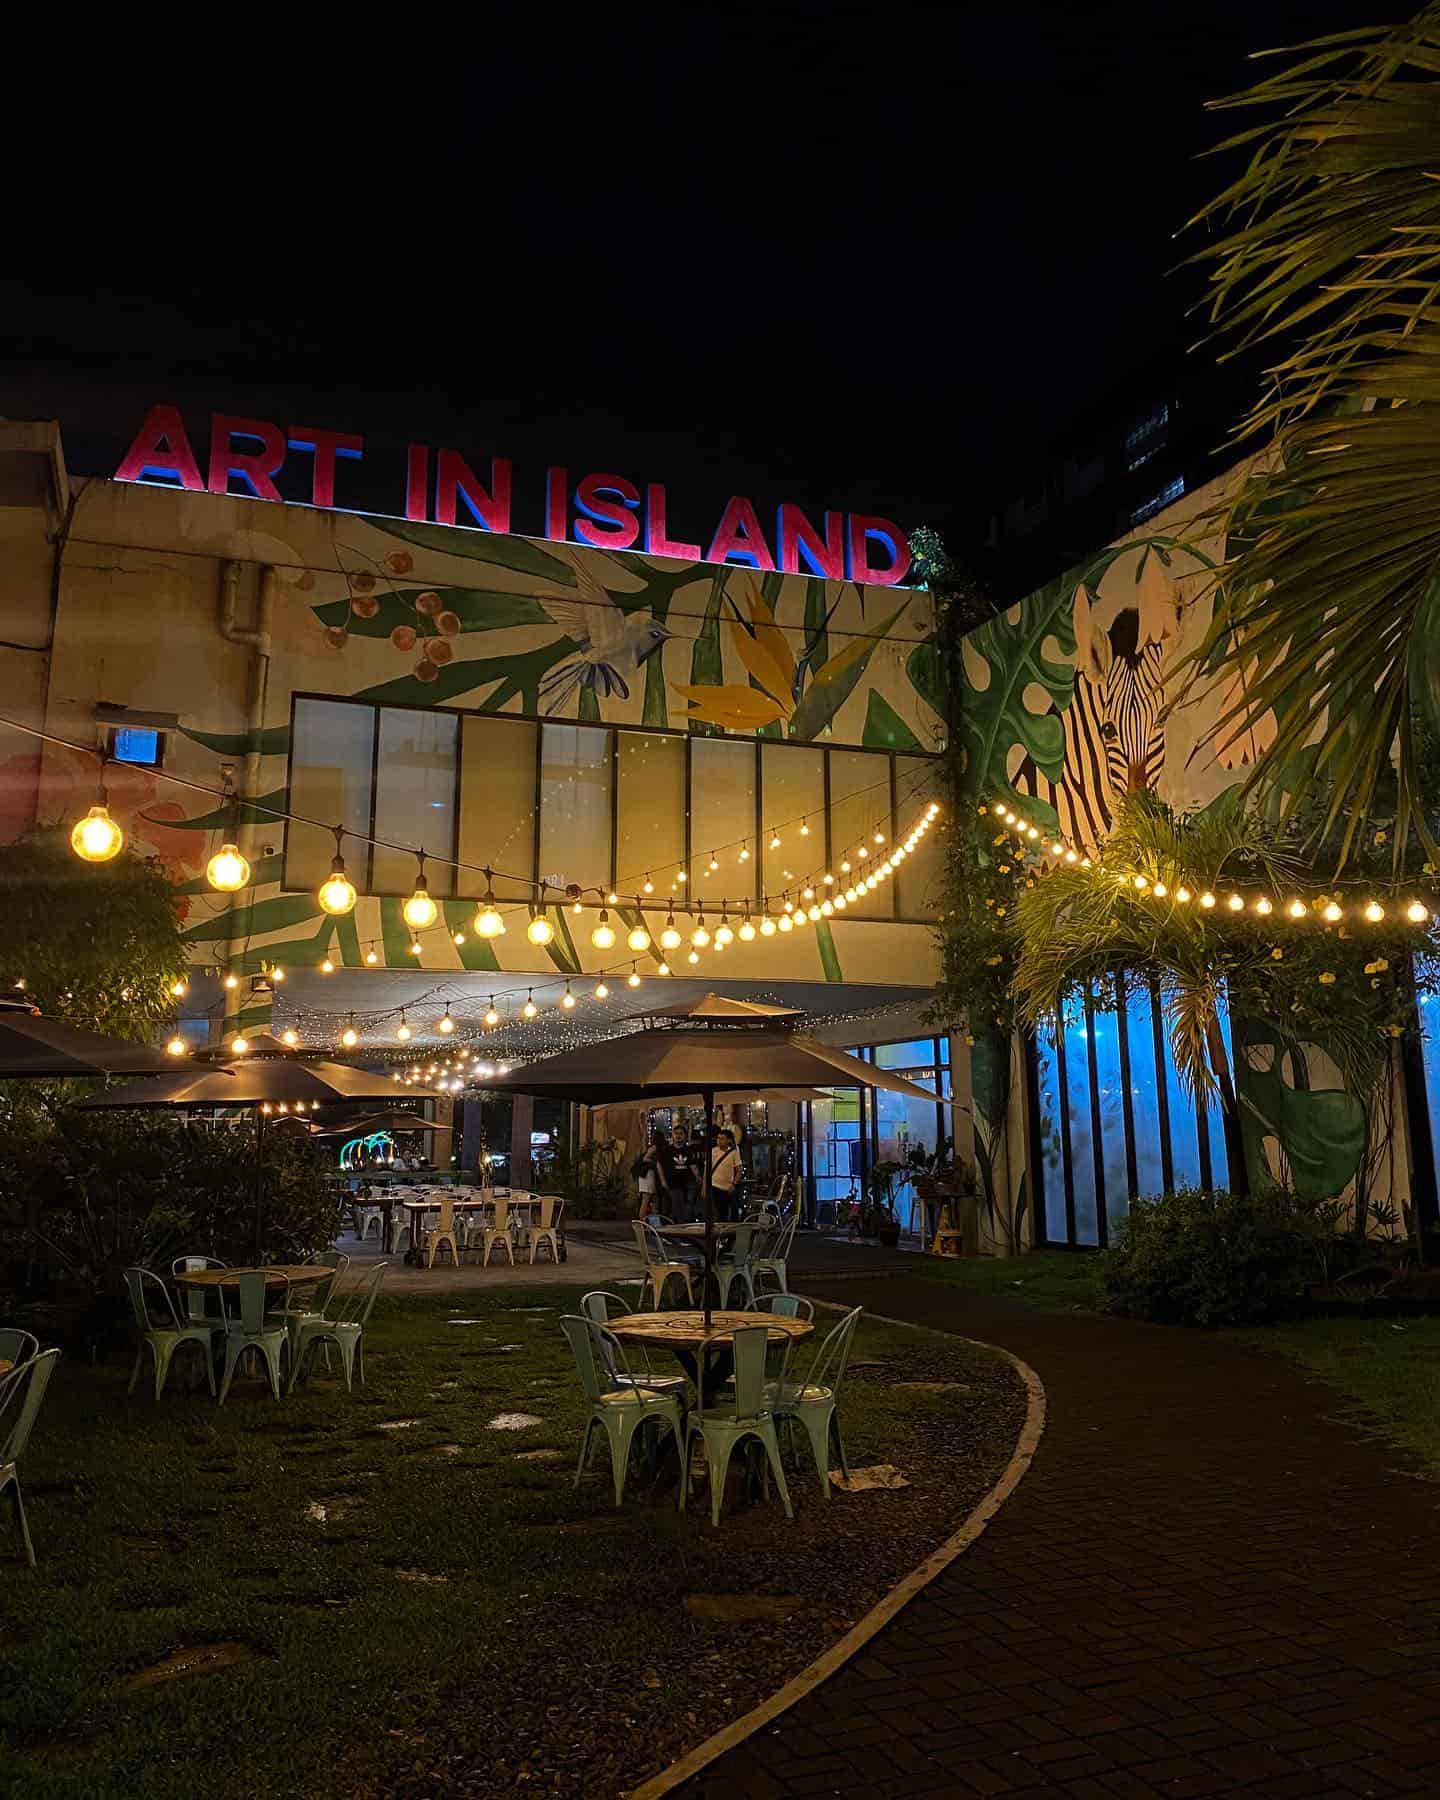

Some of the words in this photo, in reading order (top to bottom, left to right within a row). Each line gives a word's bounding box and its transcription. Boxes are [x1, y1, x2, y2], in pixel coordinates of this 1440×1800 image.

[113, 402, 364, 508] ART
[406, 443, 512, 534] IN
[544, 465, 912, 586] ISLAND
